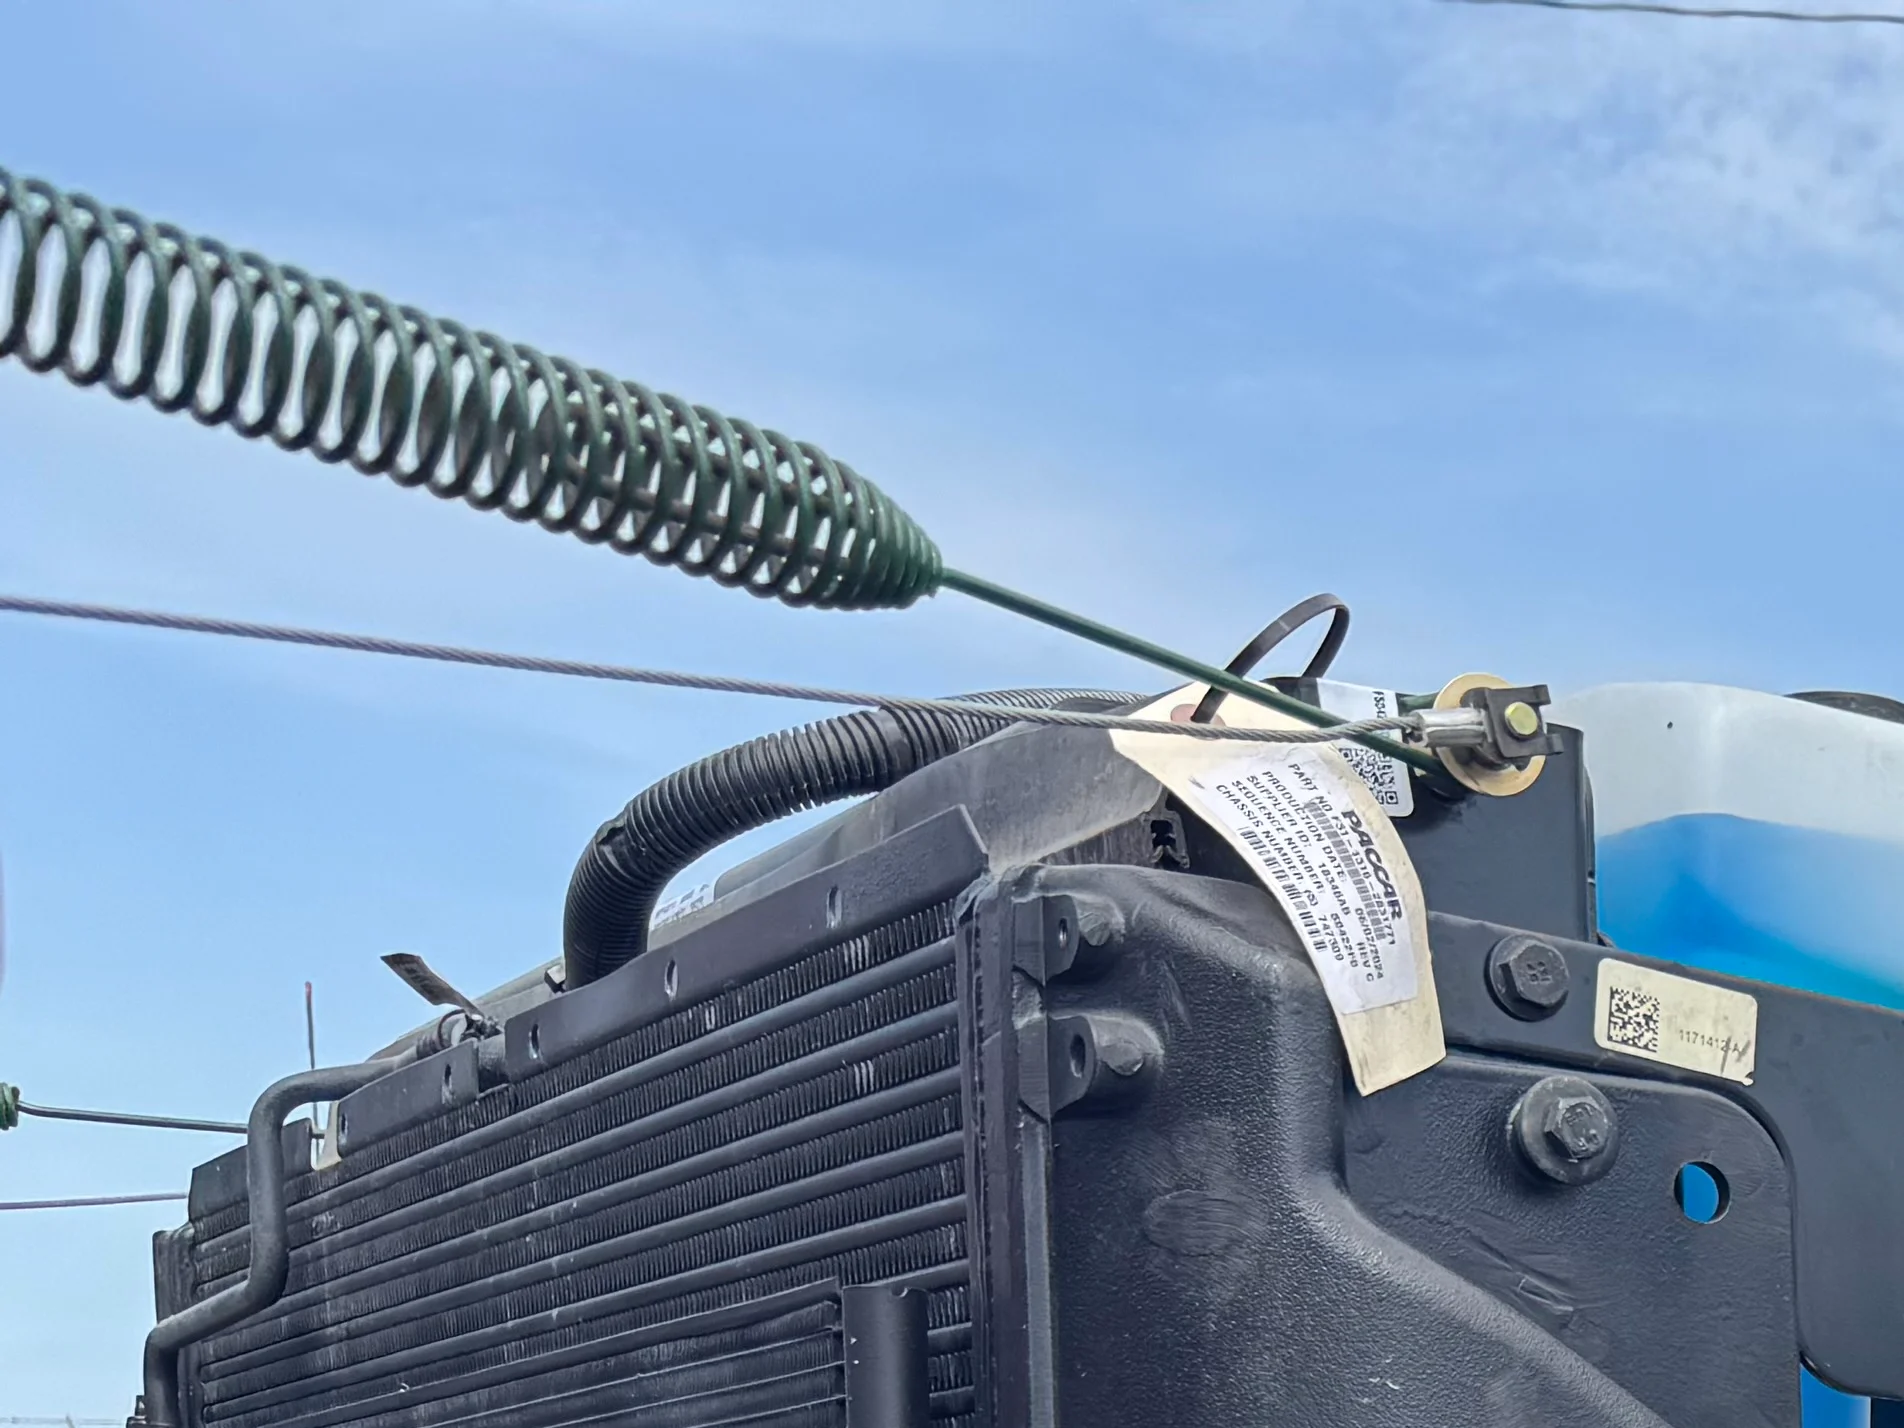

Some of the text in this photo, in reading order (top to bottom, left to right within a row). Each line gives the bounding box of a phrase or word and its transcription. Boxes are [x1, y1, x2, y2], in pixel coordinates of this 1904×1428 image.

[1247, 775, 1298, 828] SUPPLIER
[1288, 762, 1319, 792] PART
[1215, 783, 1263, 829] CHASSIS
[1231, 780, 1287, 836] SEQUENCE
[1262, 771, 1324, 842] PRODUCTION
[1342, 811, 1402, 921] PACCAR
